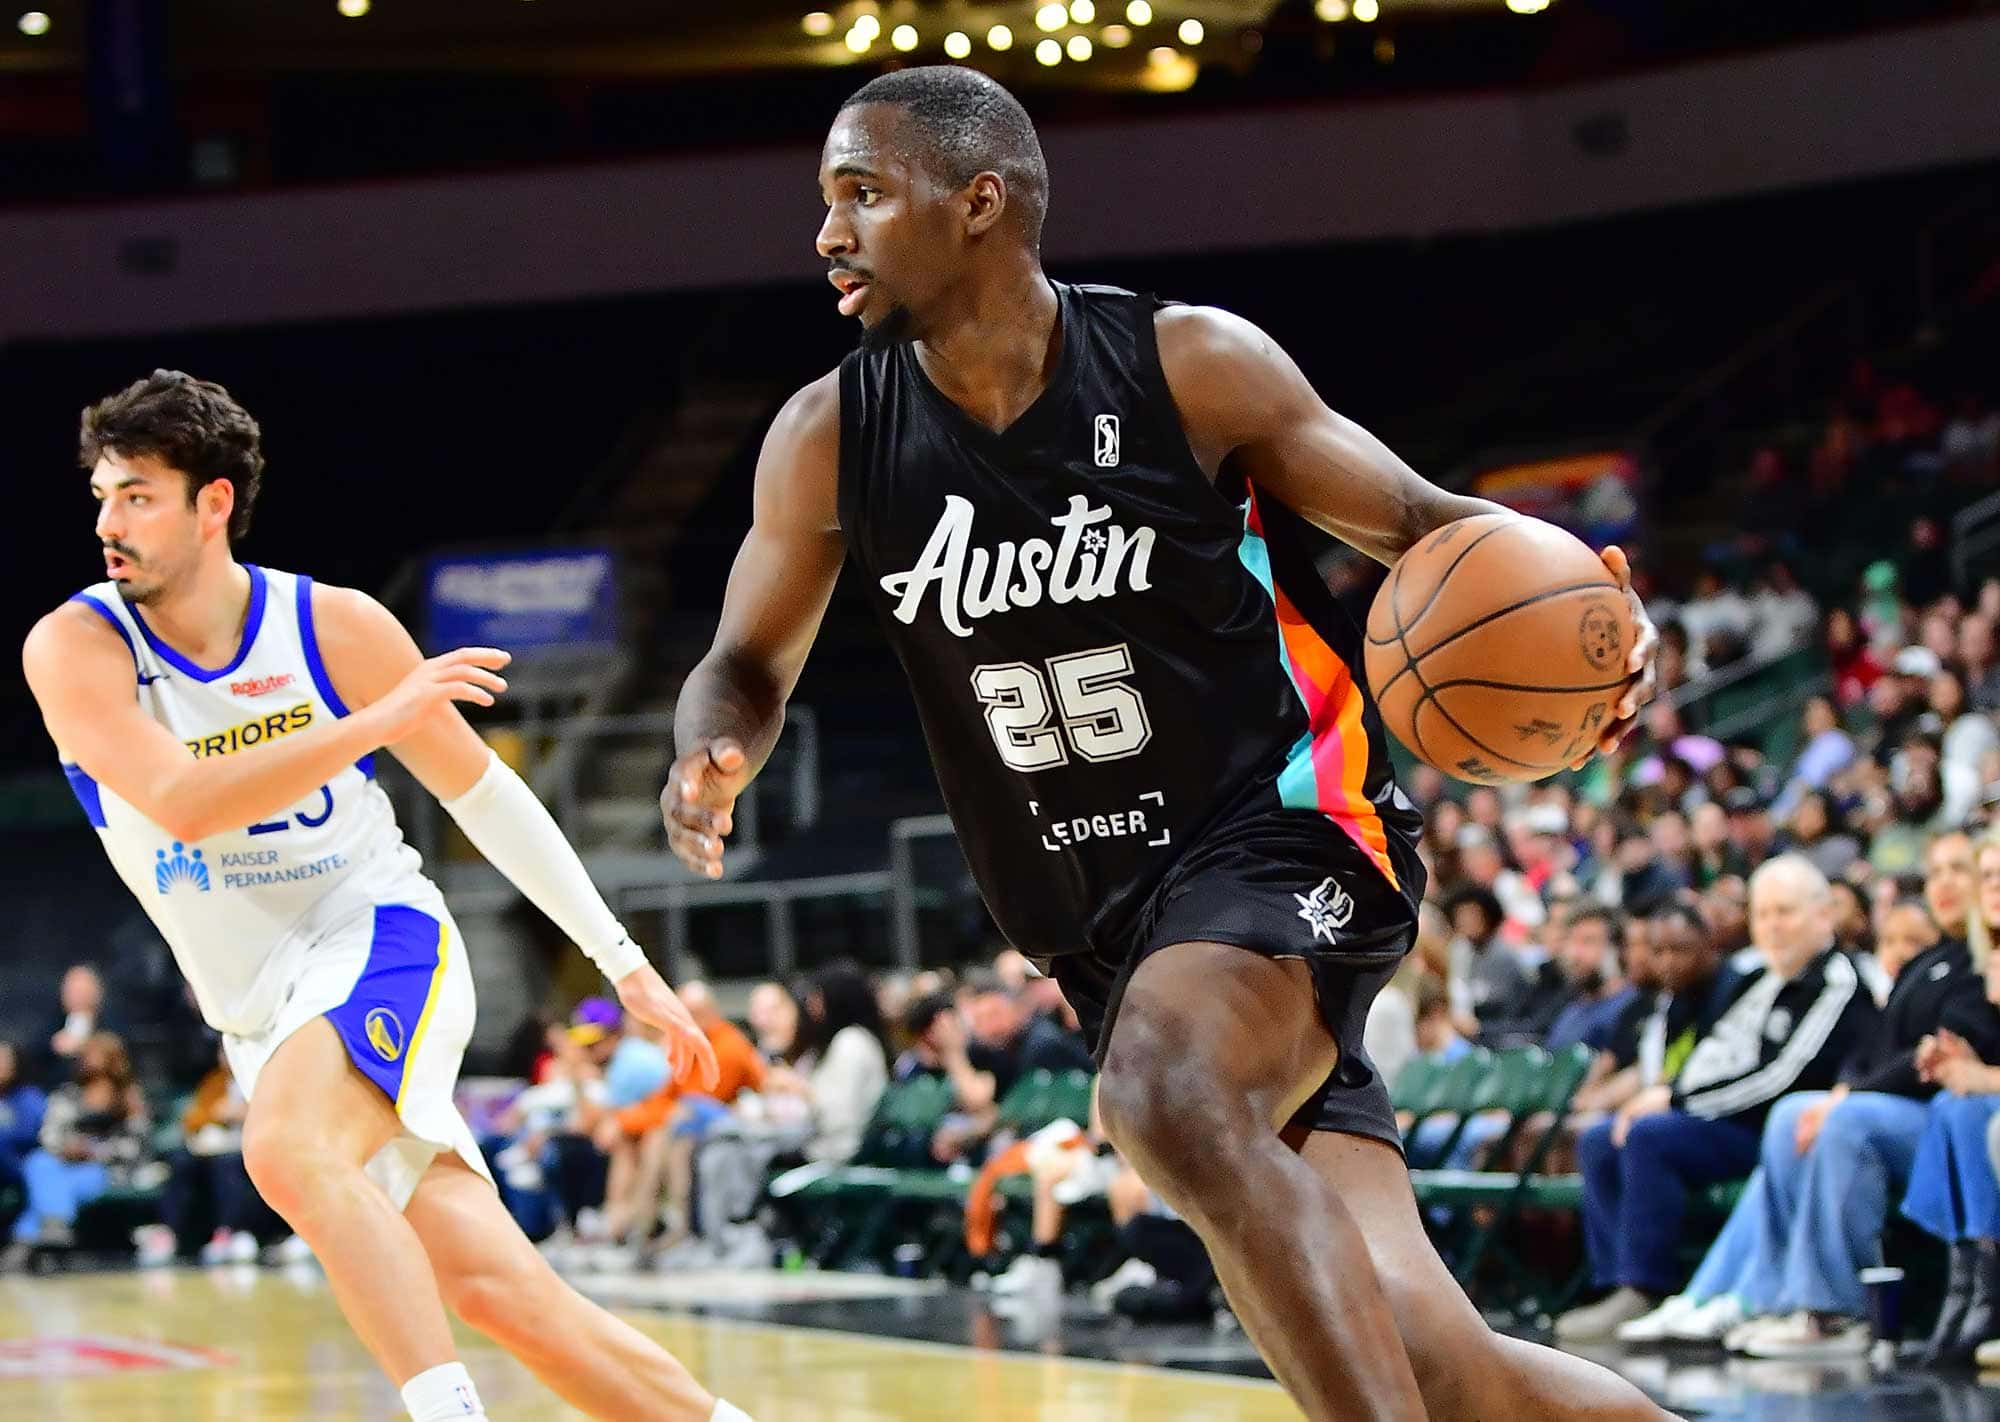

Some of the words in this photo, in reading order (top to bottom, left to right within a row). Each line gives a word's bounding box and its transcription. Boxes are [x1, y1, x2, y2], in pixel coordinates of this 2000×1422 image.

[879, 494, 1157, 637] Austin
[229, 674, 297, 697] Rakuten
[969, 642, 1153, 773] 25
[184, 702, 313, 760] RRIORS
[220, 850, 279, 867] KAISER
